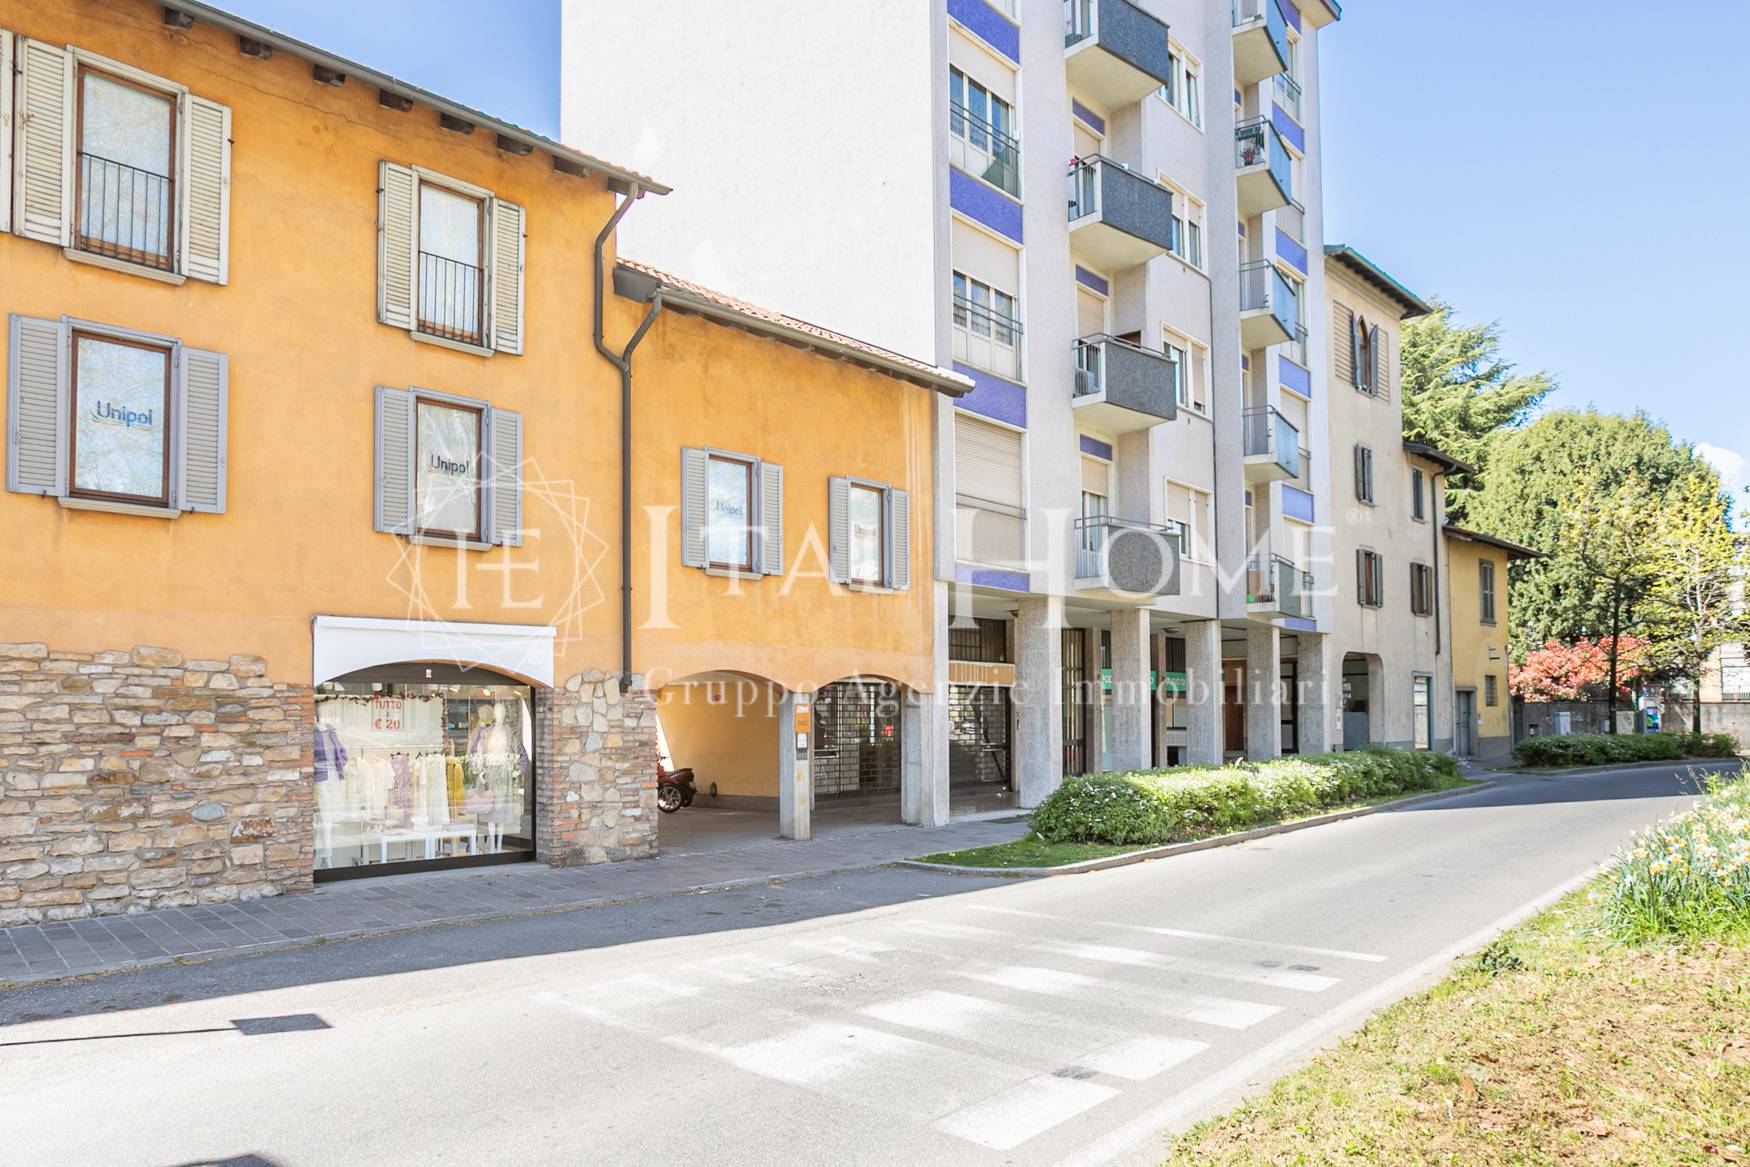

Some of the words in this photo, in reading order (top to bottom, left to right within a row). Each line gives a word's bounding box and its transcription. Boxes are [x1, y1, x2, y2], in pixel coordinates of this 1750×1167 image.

[96, 400, 153, 427] Unipol
[430, 454, 470, 476] Unipol
[374, 700, 402, 709] TUTTO
[374, 719, 382, 730] €
[385, 719, 401, 730] 20
